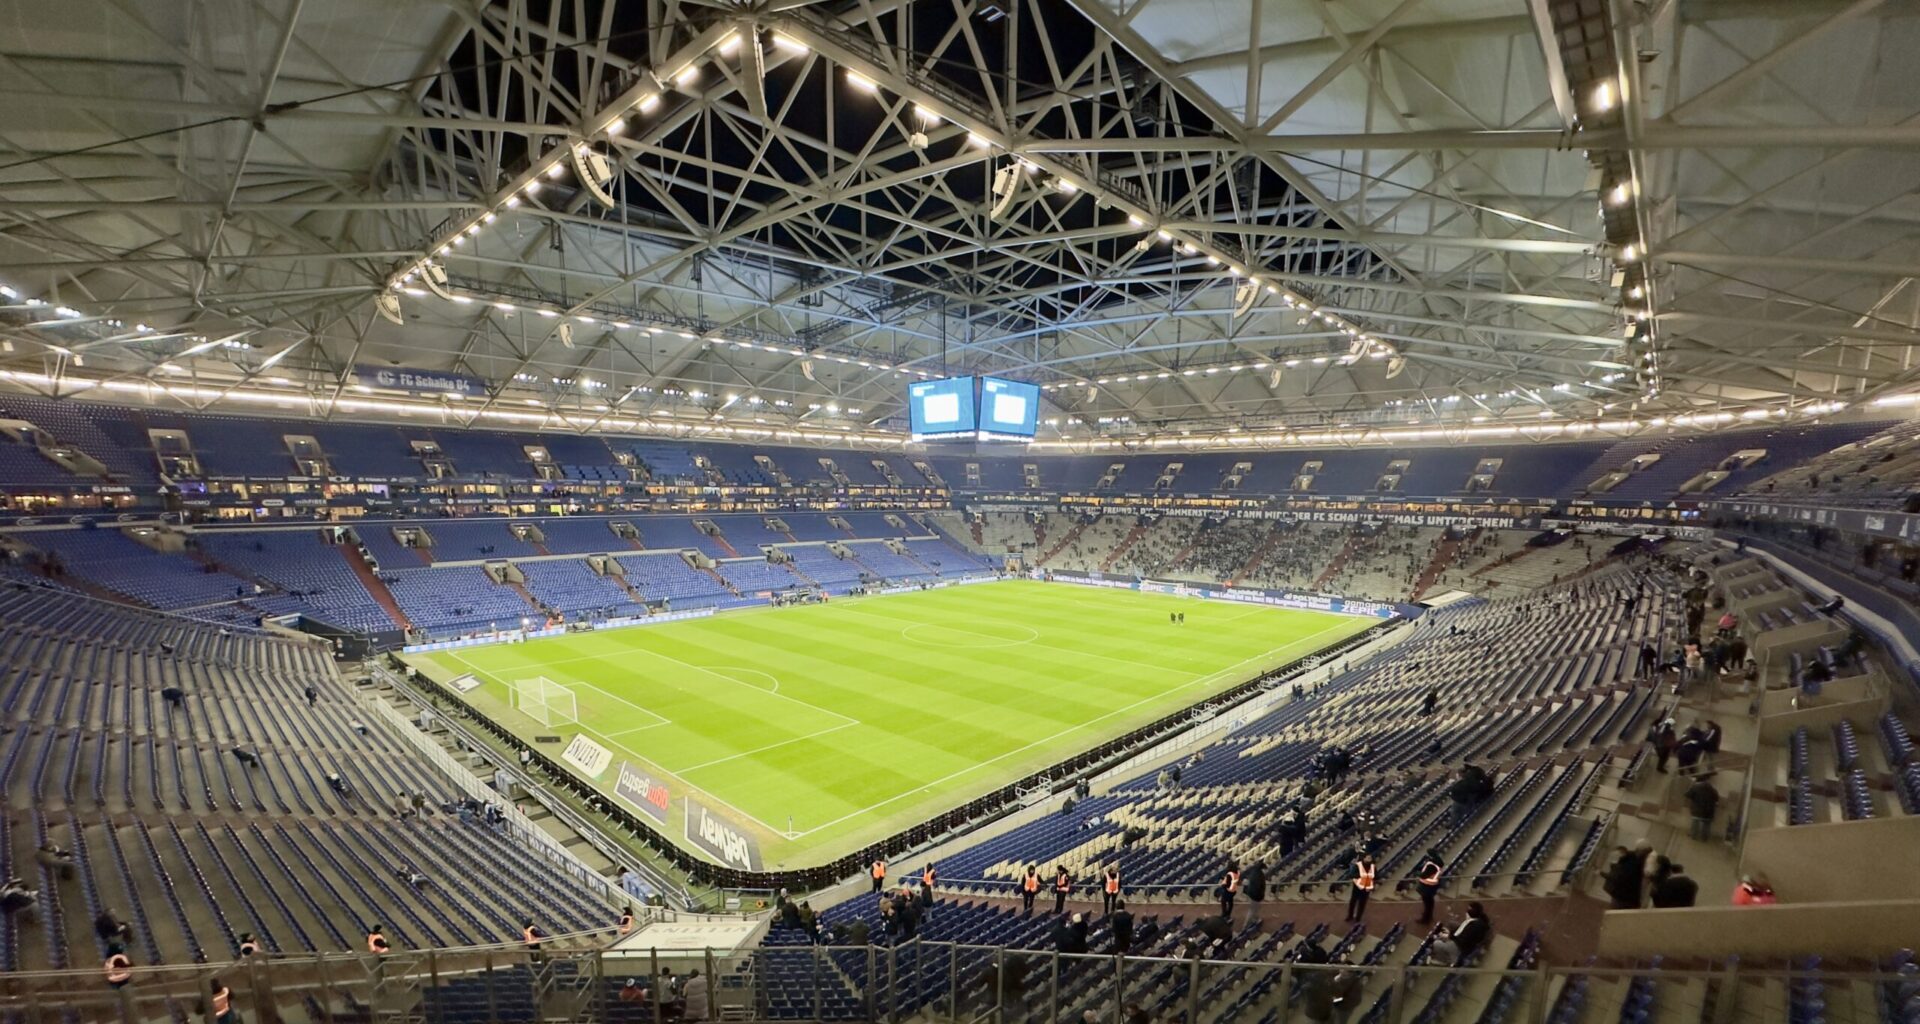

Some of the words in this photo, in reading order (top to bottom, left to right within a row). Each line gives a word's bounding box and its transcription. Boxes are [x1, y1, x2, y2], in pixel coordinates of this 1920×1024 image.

[400, 374, 414, 386] FC
[415, 375, 455, 389] Schalke
[456, 379, 470, 391] 04
[1313, 512, 1325, 521] FC
[568, 738, 600, 769] VELTINS
[622, 771, 669, 812] ggmgastro
[699, 807, 751, 871] betway
